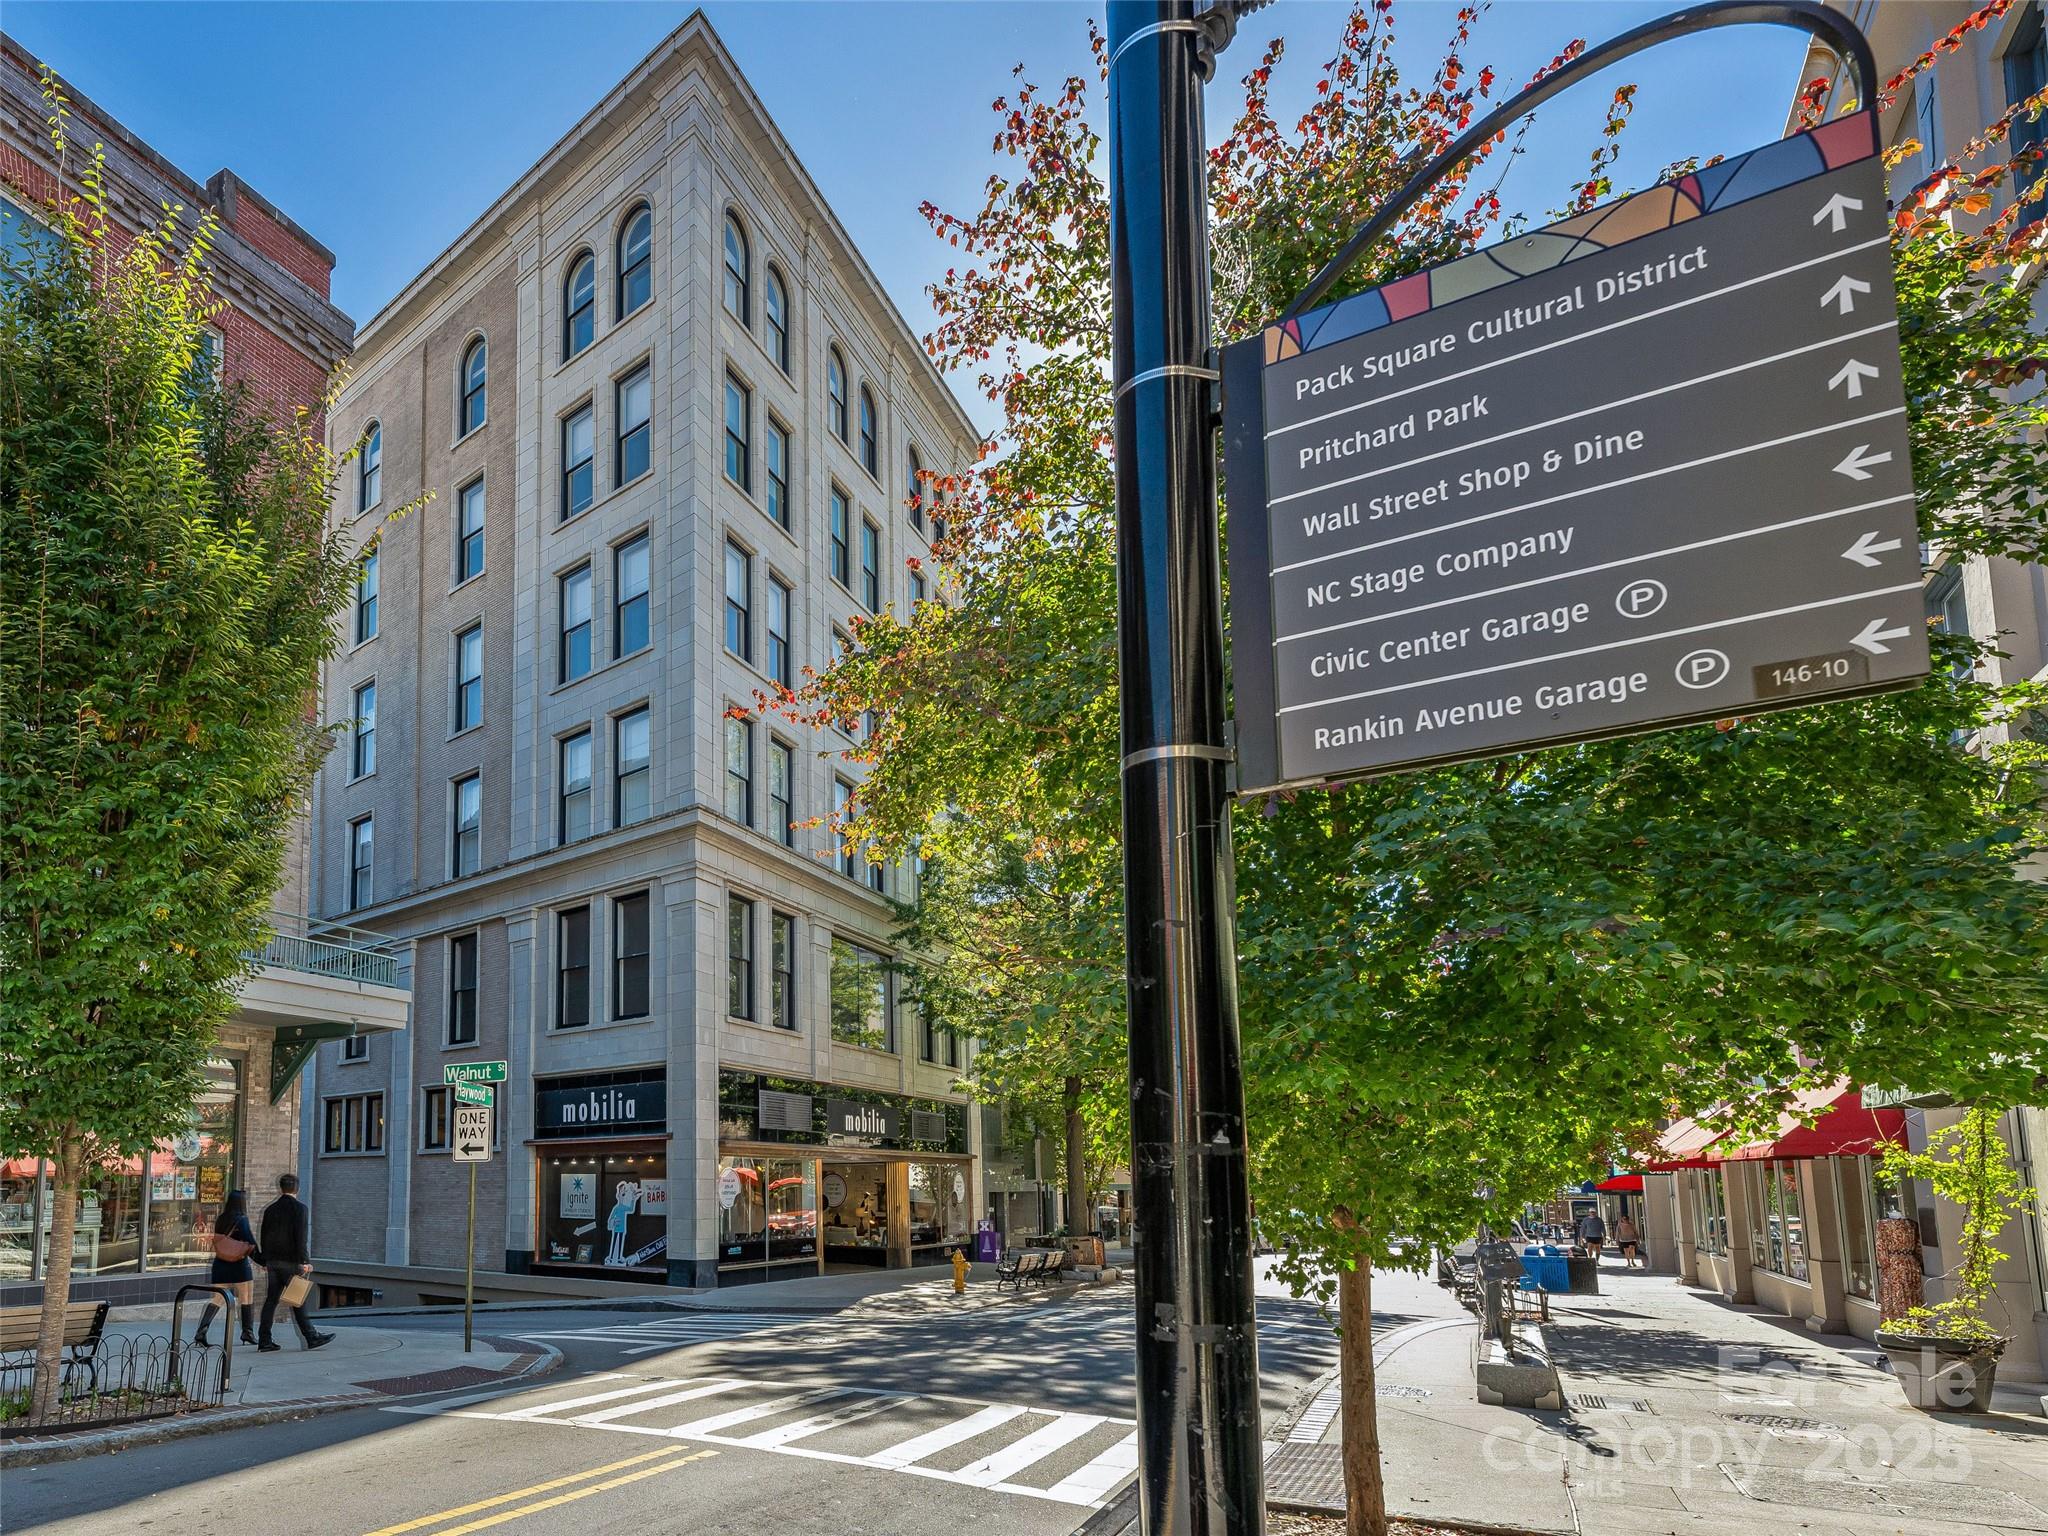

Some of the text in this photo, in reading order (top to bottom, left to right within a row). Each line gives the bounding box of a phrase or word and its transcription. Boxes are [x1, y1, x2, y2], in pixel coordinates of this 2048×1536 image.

[1295, 245, 1708, 400] Pack Square Cultural District
[1299, 394, 1489, 470] Pritchard Park
[1302, 427, 1644, 537] Wall Street Shop & Dine
[1307, 526, 1574, 608] NC Stage Company
[1310, 647, 1370, 678] Civic
[1379, 624, 1471, 663] Center
[1481, 602, 1590, 642] Garage
[1772, 659, 1849, 686] 146-10
[1314, 714, 1404, 750] Rankin
[1415, 695, 1523, 733] Avenue
[1534, 672, 1648, 710] Garage
[446, 1064, 505, 1082] Walnut St
[457, 1081, 486, 1102] Haywood
[460, 1112, 487, 1125] ONE
[562, 1090, 635, 1123] mobilia
[459, 1127, 487, 1140] WAY
[845, 1107, 886, 1134] mobilia
[567, 1191, 589, 1208] ignite
[647, 1190, 667, 1203] BARB
